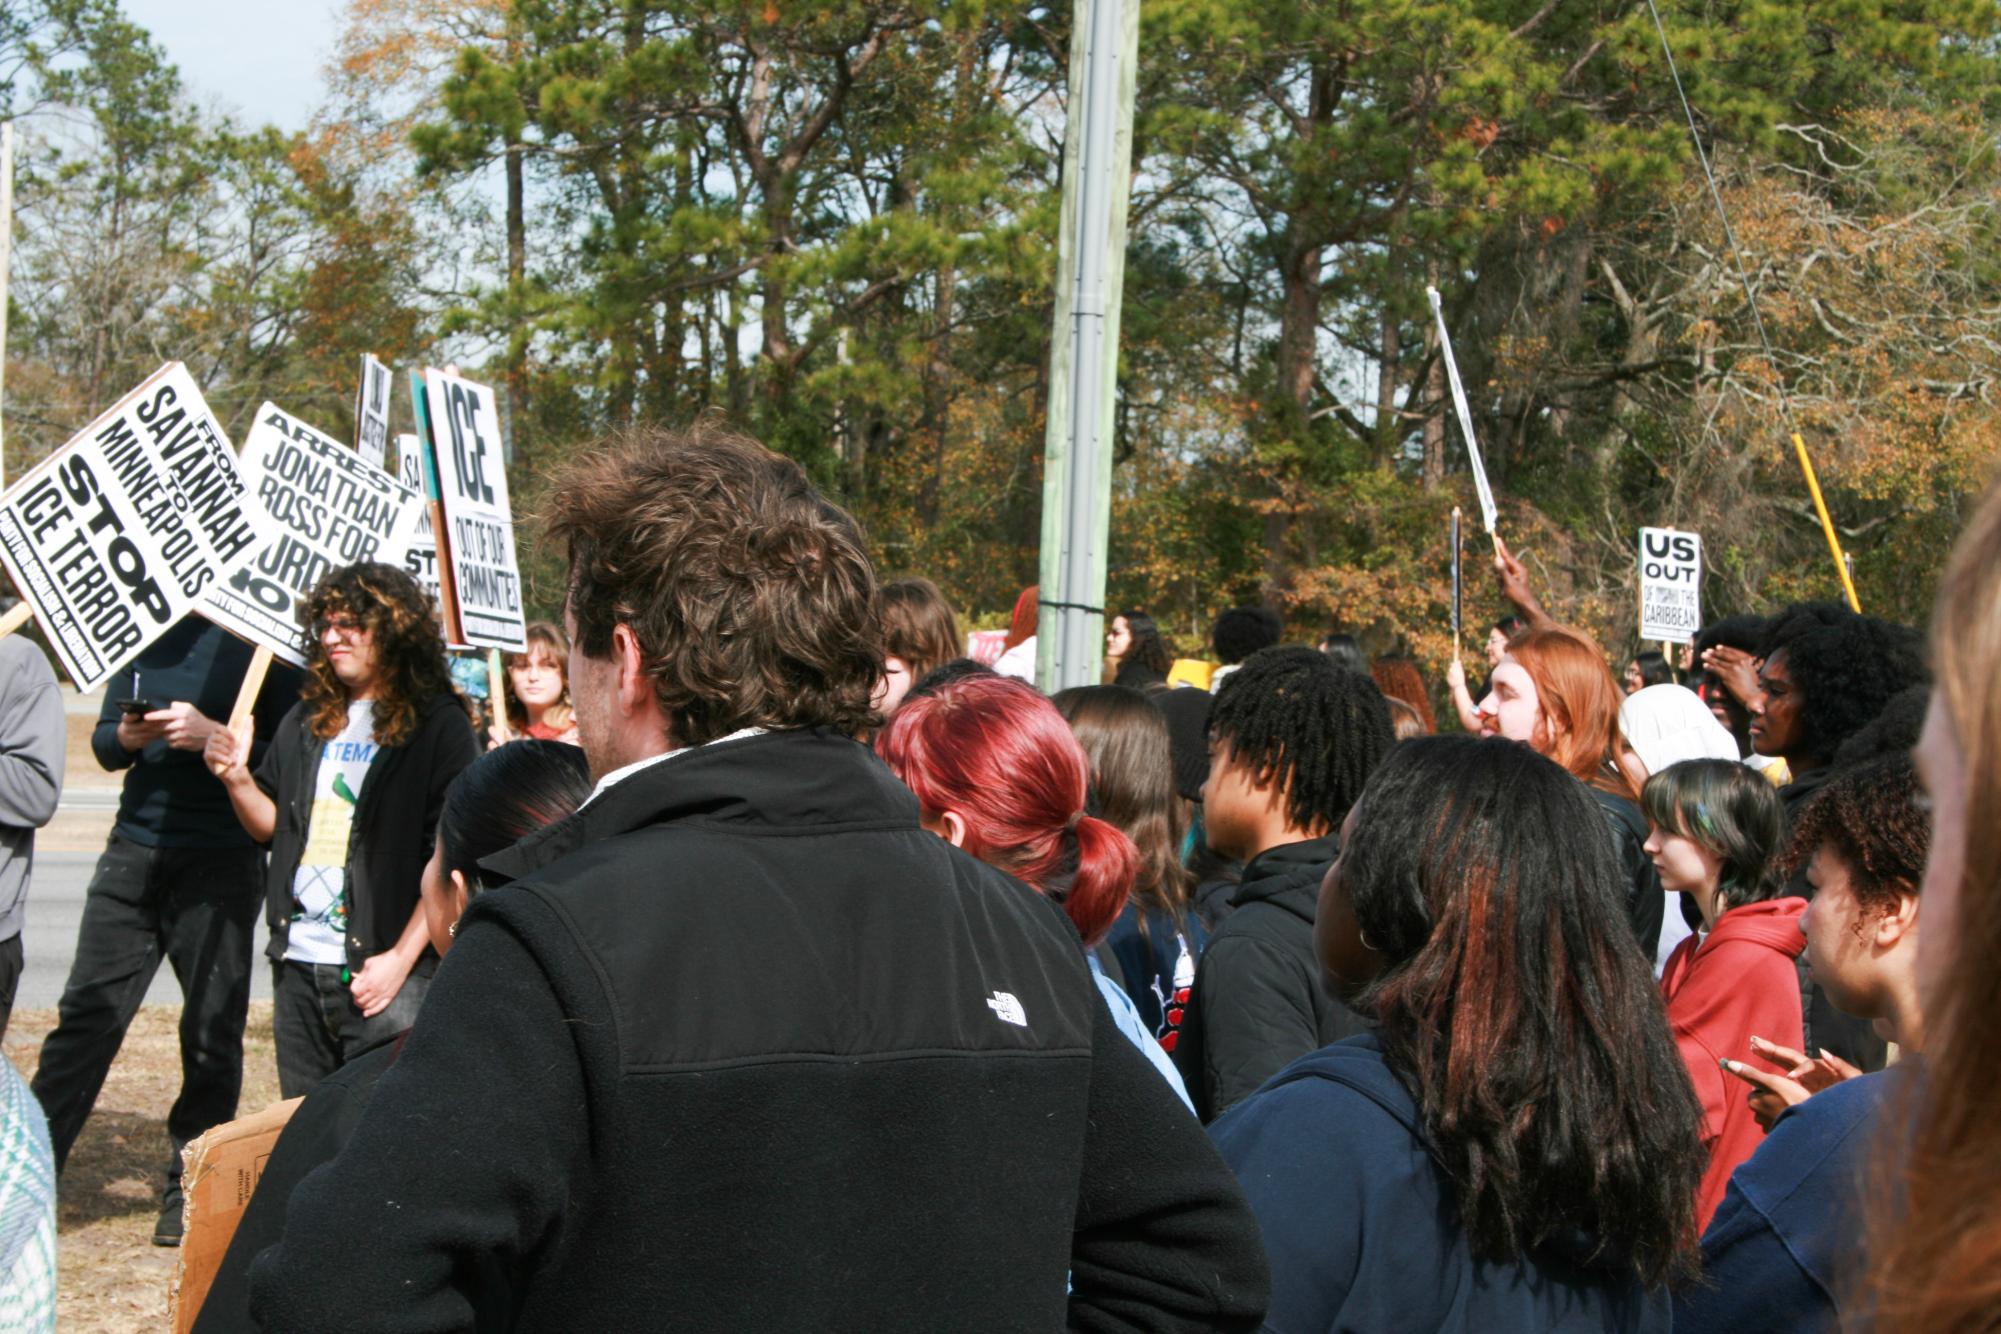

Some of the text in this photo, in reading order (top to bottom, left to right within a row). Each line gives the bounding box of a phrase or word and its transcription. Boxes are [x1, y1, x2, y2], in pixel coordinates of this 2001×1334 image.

[136, 385, 257, 564] SAVANNAH
[197, 419, 246, 496] FROM
[264, 412, 418, 504] ARREST
[442, 380, 495, 506] ICE
[95, 416, 215, 598] MINNEAPOLIS
[165, 473, 189, 513] TO
[258, 474, 328, 541] ROSS
[324, 514, 380, 563] FOR
[262, 440, 400, 539] JONATHAN
[16, 476, 143, 665] ICE TERROR
[59, 454, 171, 624] STOP
[248, 533, 333, 594] URD
[1645, 533, 1695, 562] US
[1645, 563, 1695, 582] OUT
[50, 608, 70, 629] &
[1644, 603, 1696, 628] CARIBBEAN
